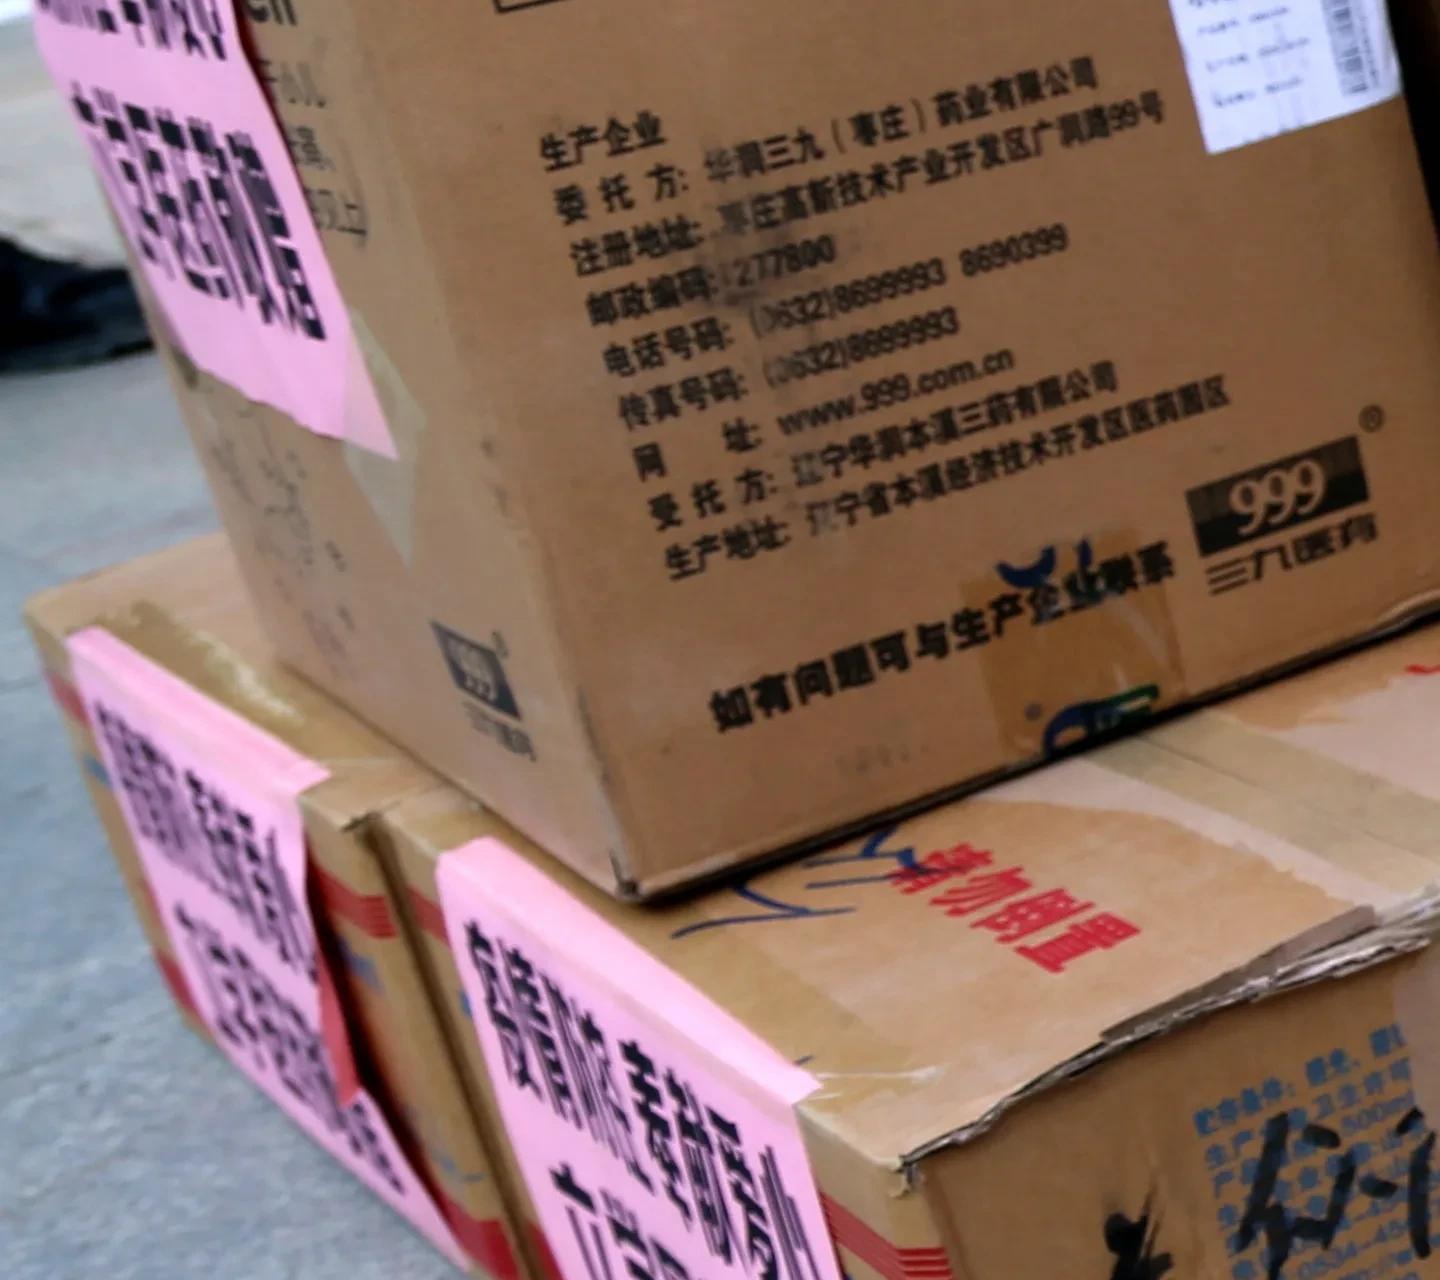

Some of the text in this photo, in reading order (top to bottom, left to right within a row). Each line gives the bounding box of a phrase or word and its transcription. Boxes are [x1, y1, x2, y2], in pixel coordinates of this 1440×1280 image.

[539, 110, 668, 173] 生产企业
[778, 349, 1015, 436] www.999.com.cn
[1229, 460, 1326, 536] 999
[708, 540, 1175, 733] 如有问题可与生产企业联系
[883, 841, 1141, 973] 请勿倒置
[465, 921, 655, 1195] 疫情防控
